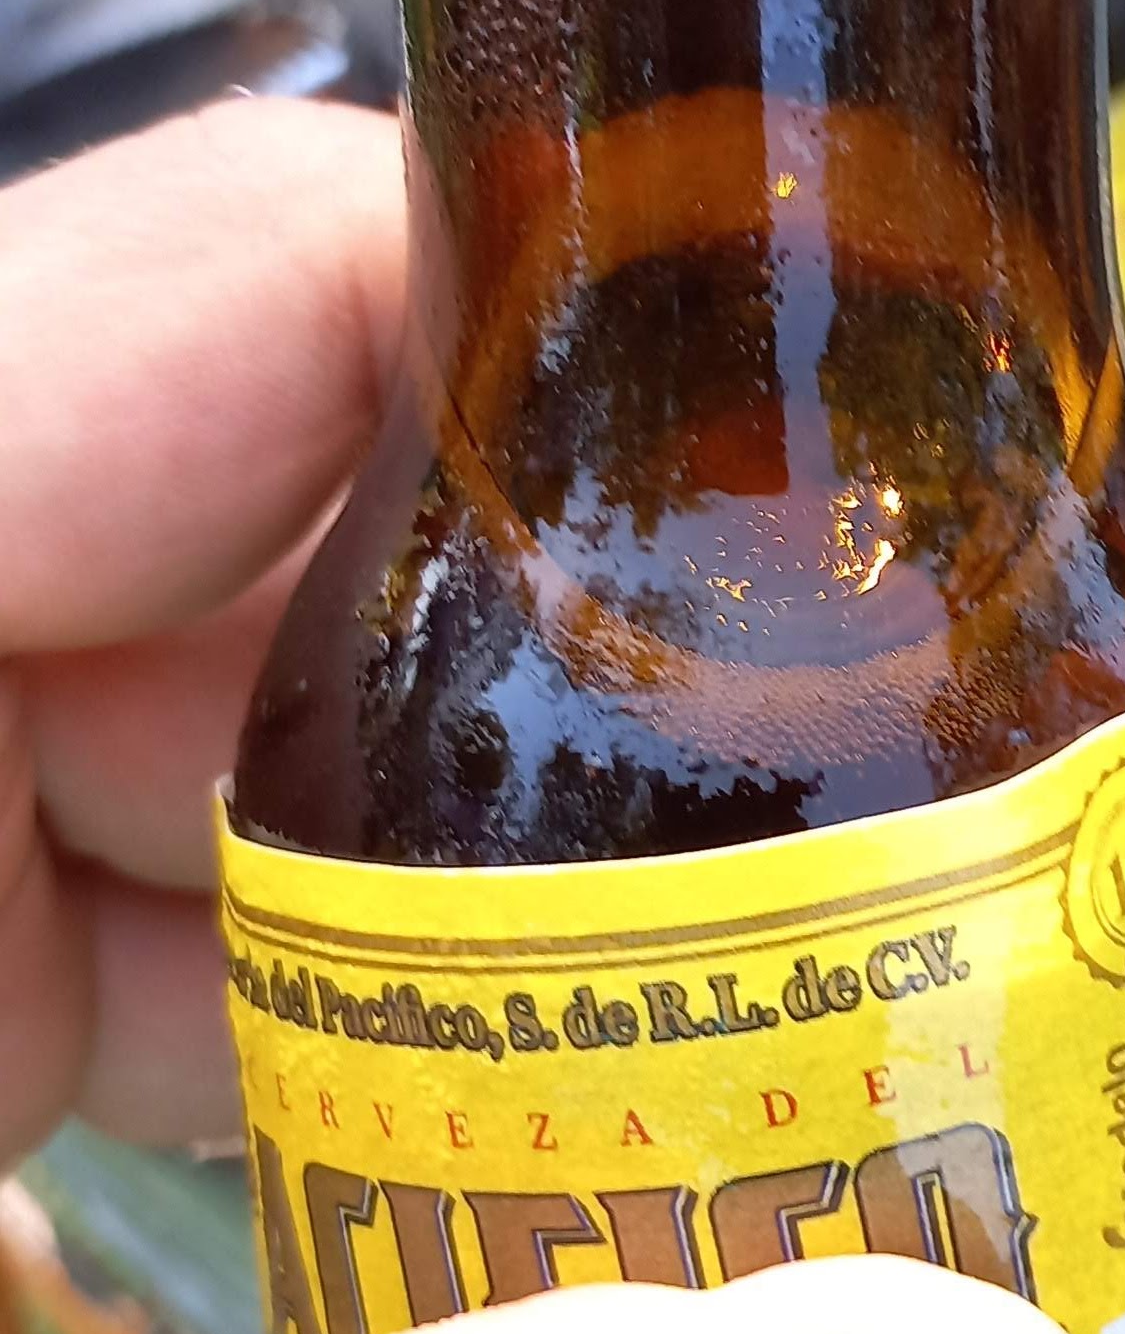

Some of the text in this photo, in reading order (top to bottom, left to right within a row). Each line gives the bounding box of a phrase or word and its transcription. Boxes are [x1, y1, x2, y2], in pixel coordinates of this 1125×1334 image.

[269, 957, 318, 1031] del
[504, 992, 560, 1052] S.
[562, 984, 638, 1051] de
[782, 953, 864, 1023] de
[866, 924, 972, 1002] C.V.
[759, 1041, 990, 1129] DEL
